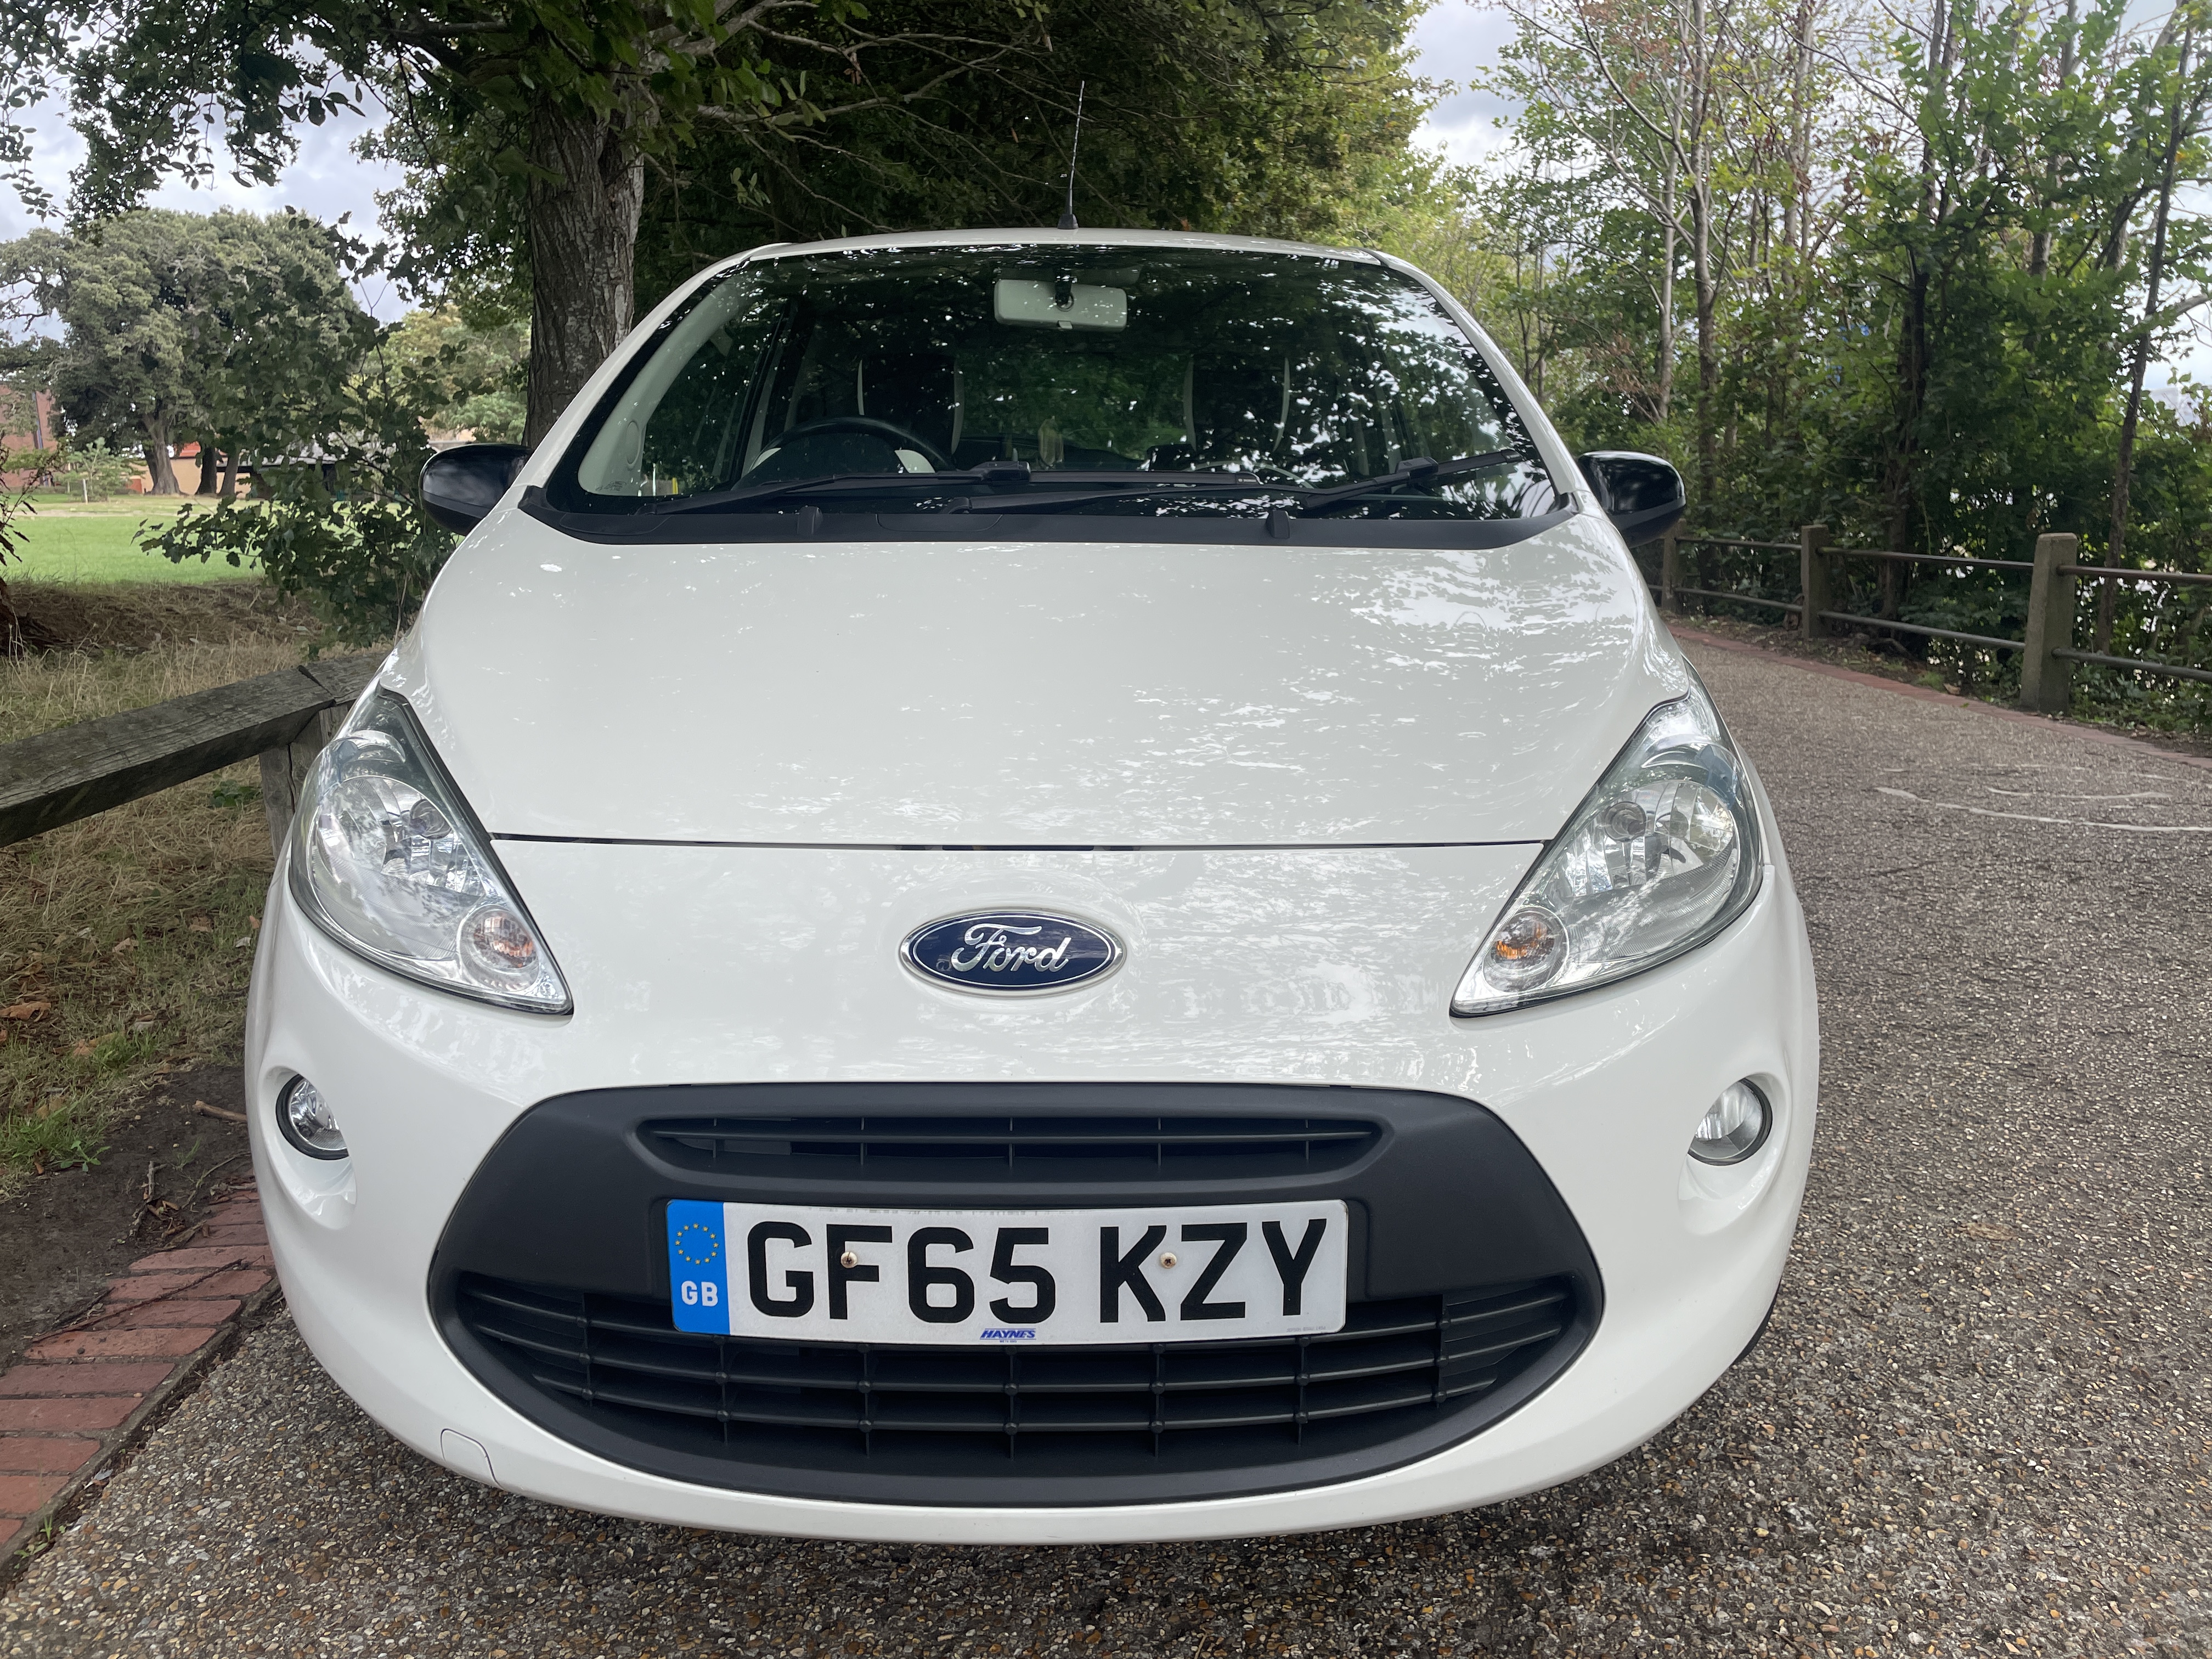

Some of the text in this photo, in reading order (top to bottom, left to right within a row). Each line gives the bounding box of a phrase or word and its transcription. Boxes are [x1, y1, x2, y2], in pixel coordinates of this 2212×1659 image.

[951, 923, 1071, 972] Ford
[748, 1218, 1327, 1323] GF65 KZY
[682, 1280, 718, 1306] GB
[980, 1330, 1036, 1338] HAYNES
